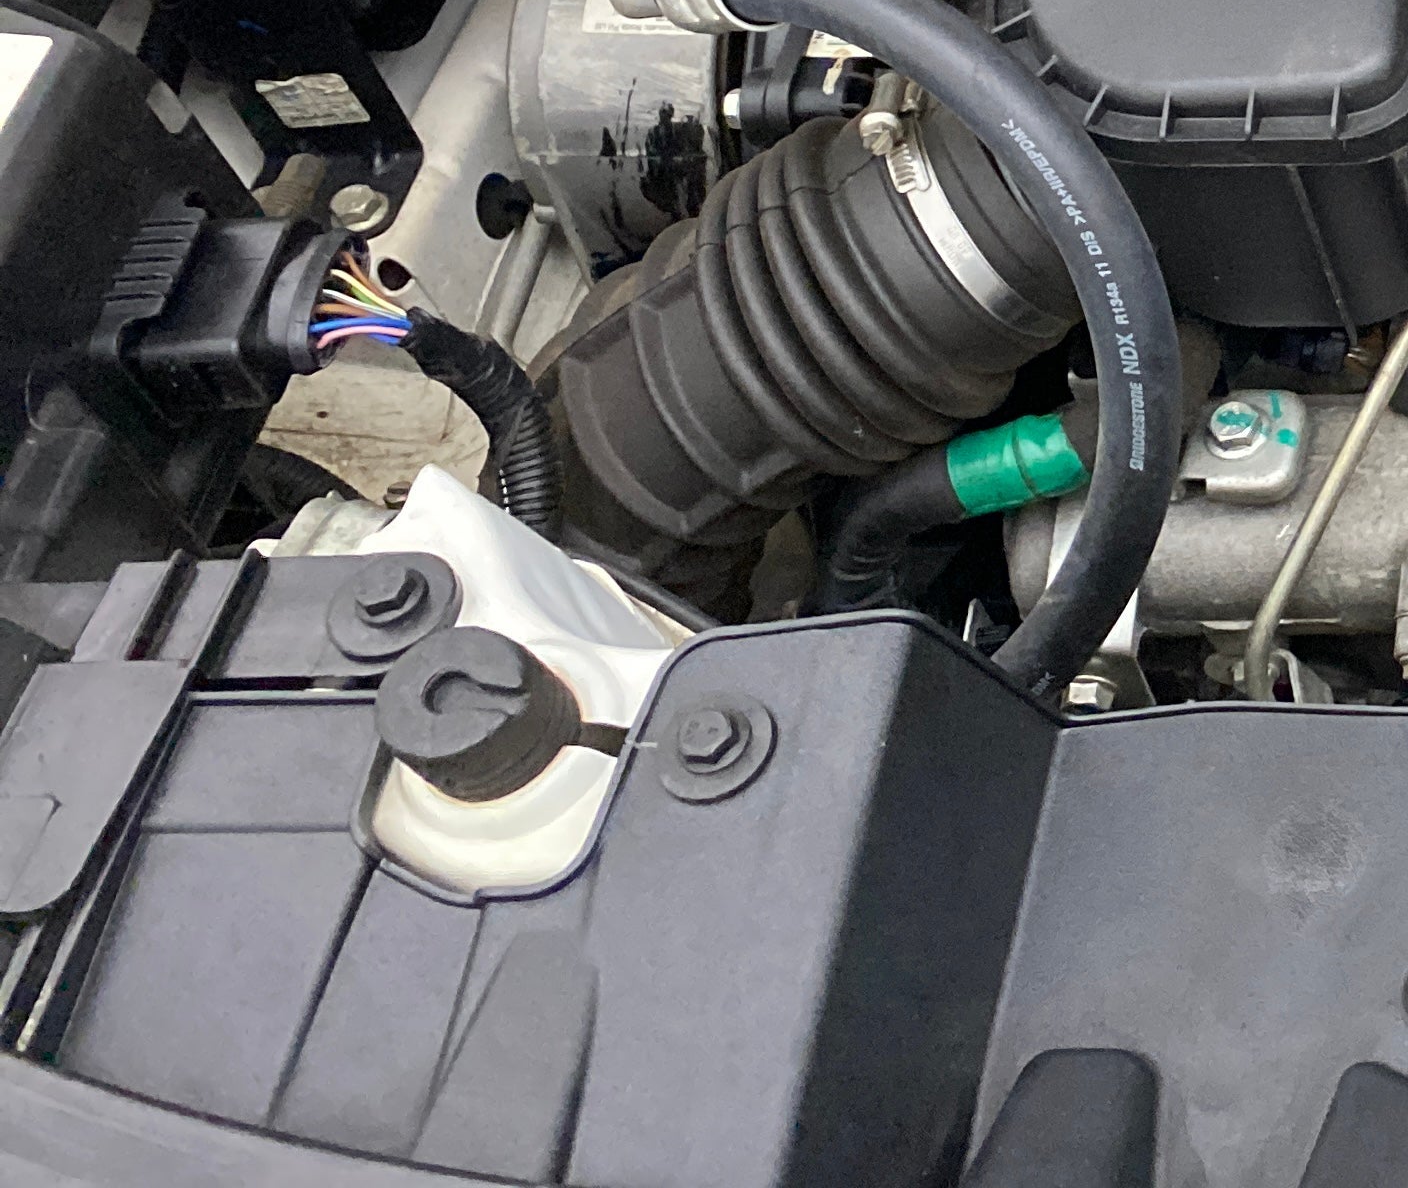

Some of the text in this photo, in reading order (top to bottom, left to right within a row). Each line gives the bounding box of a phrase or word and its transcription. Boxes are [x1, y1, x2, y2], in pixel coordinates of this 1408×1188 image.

[1080, 230, 1103, 256] DIS
[1095, 262, 1112, 277] 11
[1115, 332, 1141, 375] NDX
[1129, 381, 1145, 471] BRIDGESTONE
